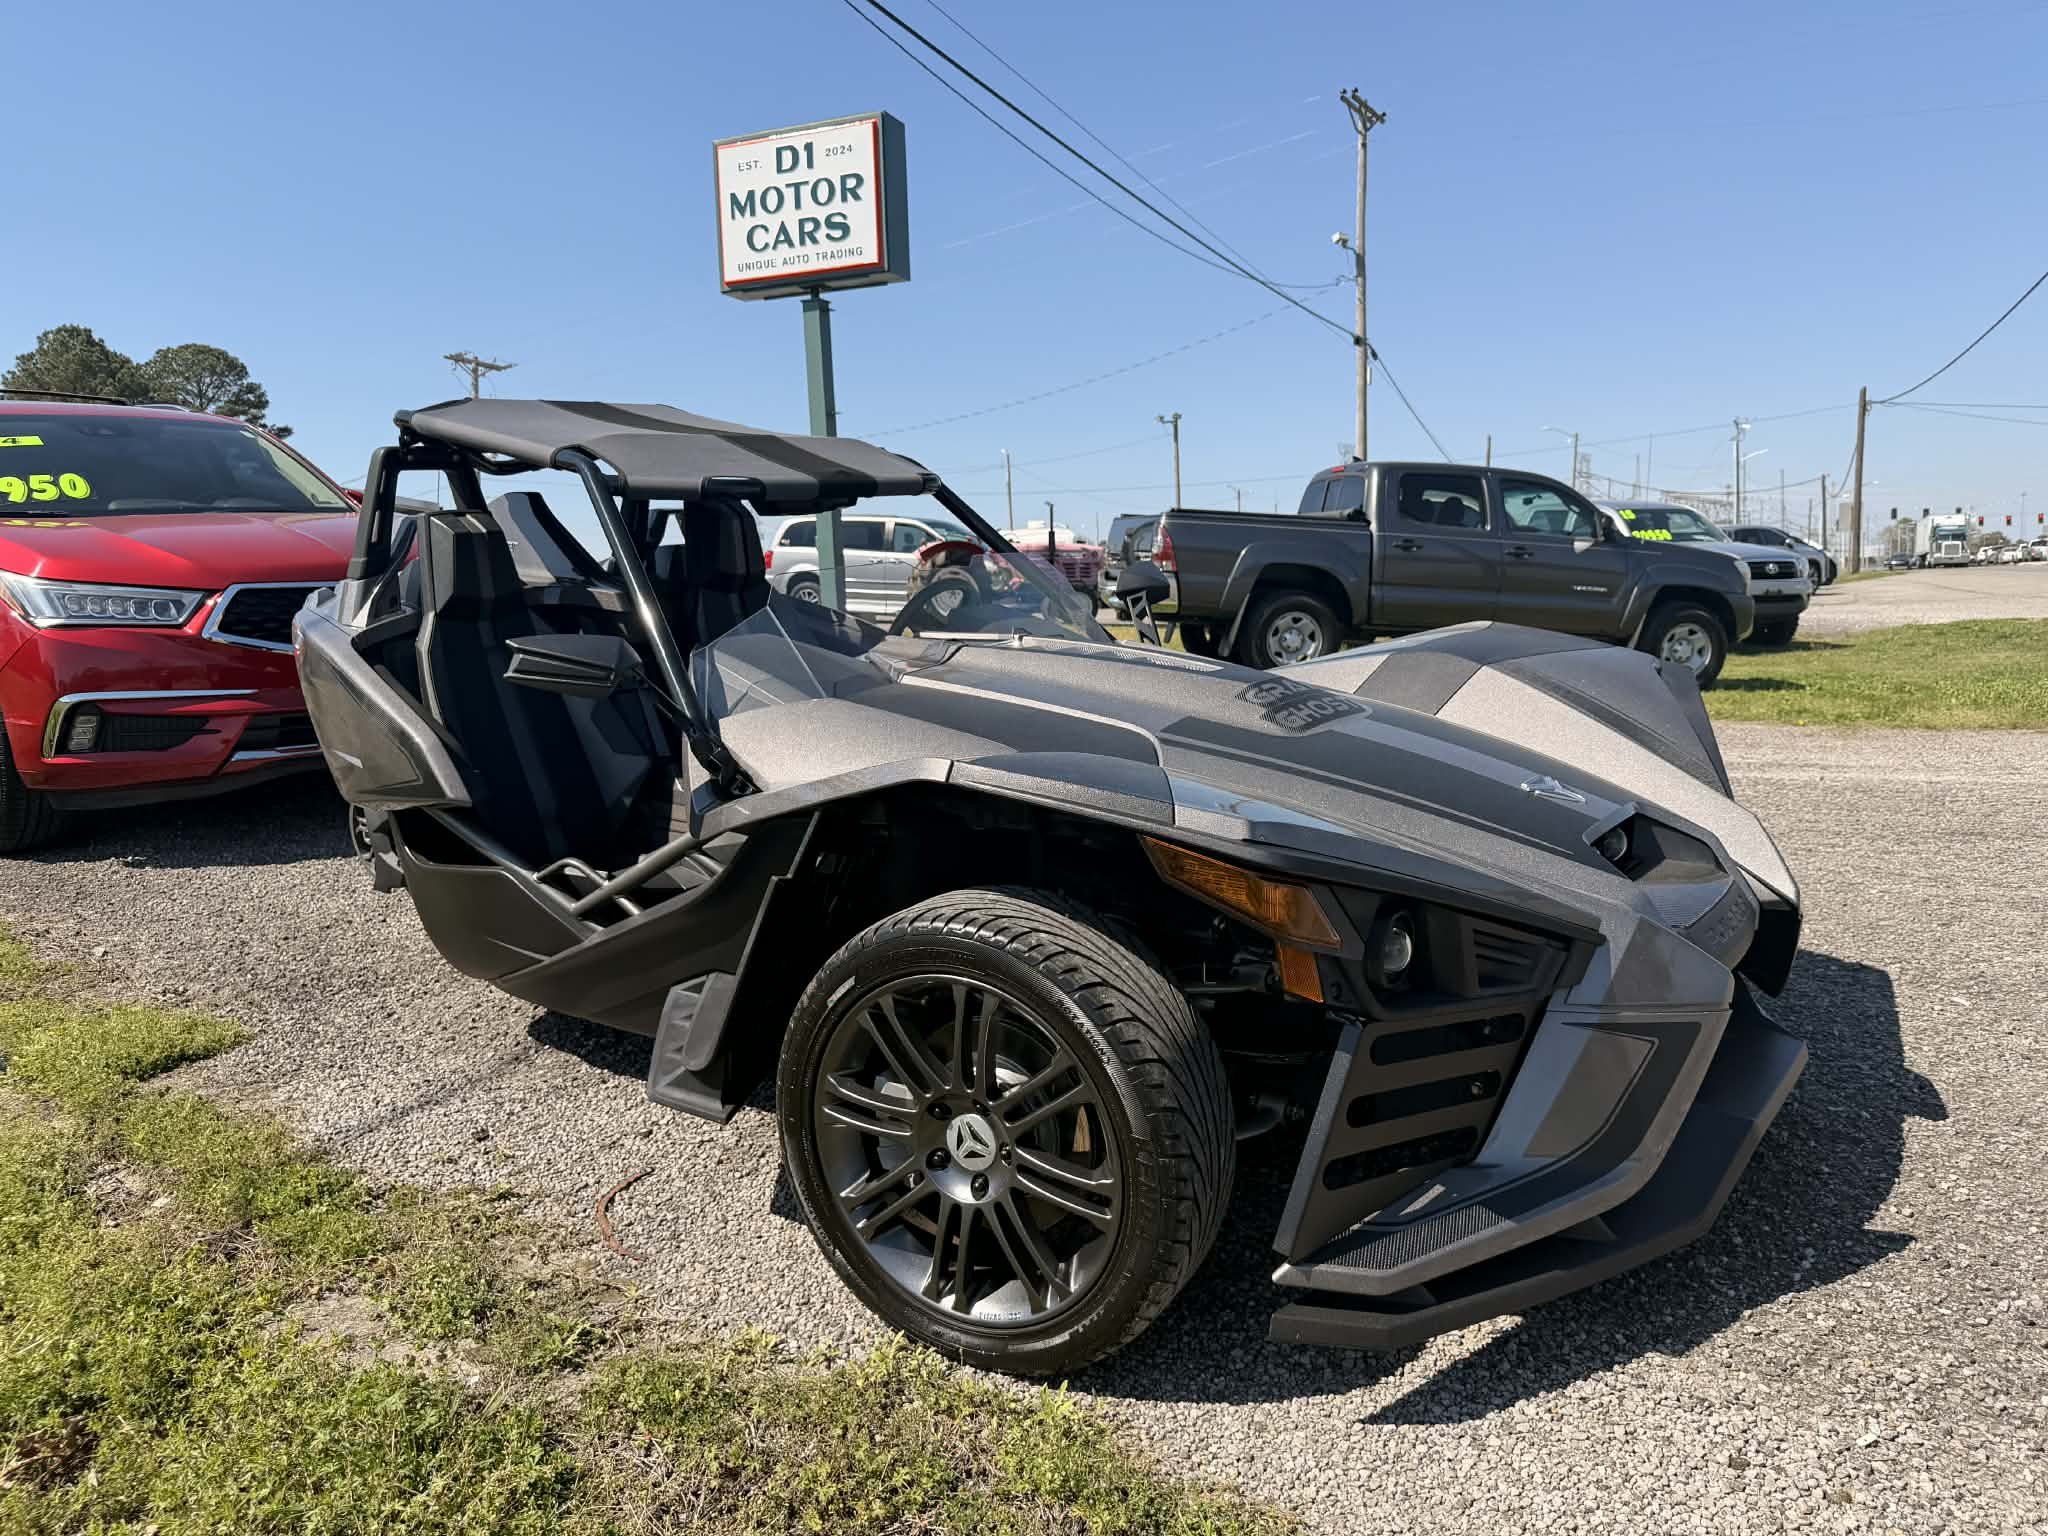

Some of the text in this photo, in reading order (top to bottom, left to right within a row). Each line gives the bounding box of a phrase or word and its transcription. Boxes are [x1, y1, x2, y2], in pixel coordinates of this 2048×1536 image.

[738, 142, 853, 174] EST. D1 2024
[730, 173, 864, 221] MOTOR
[746, 212, 851, 252] CARS
[737, 247, 863, 273] UNIQUE AUTO TRADING
